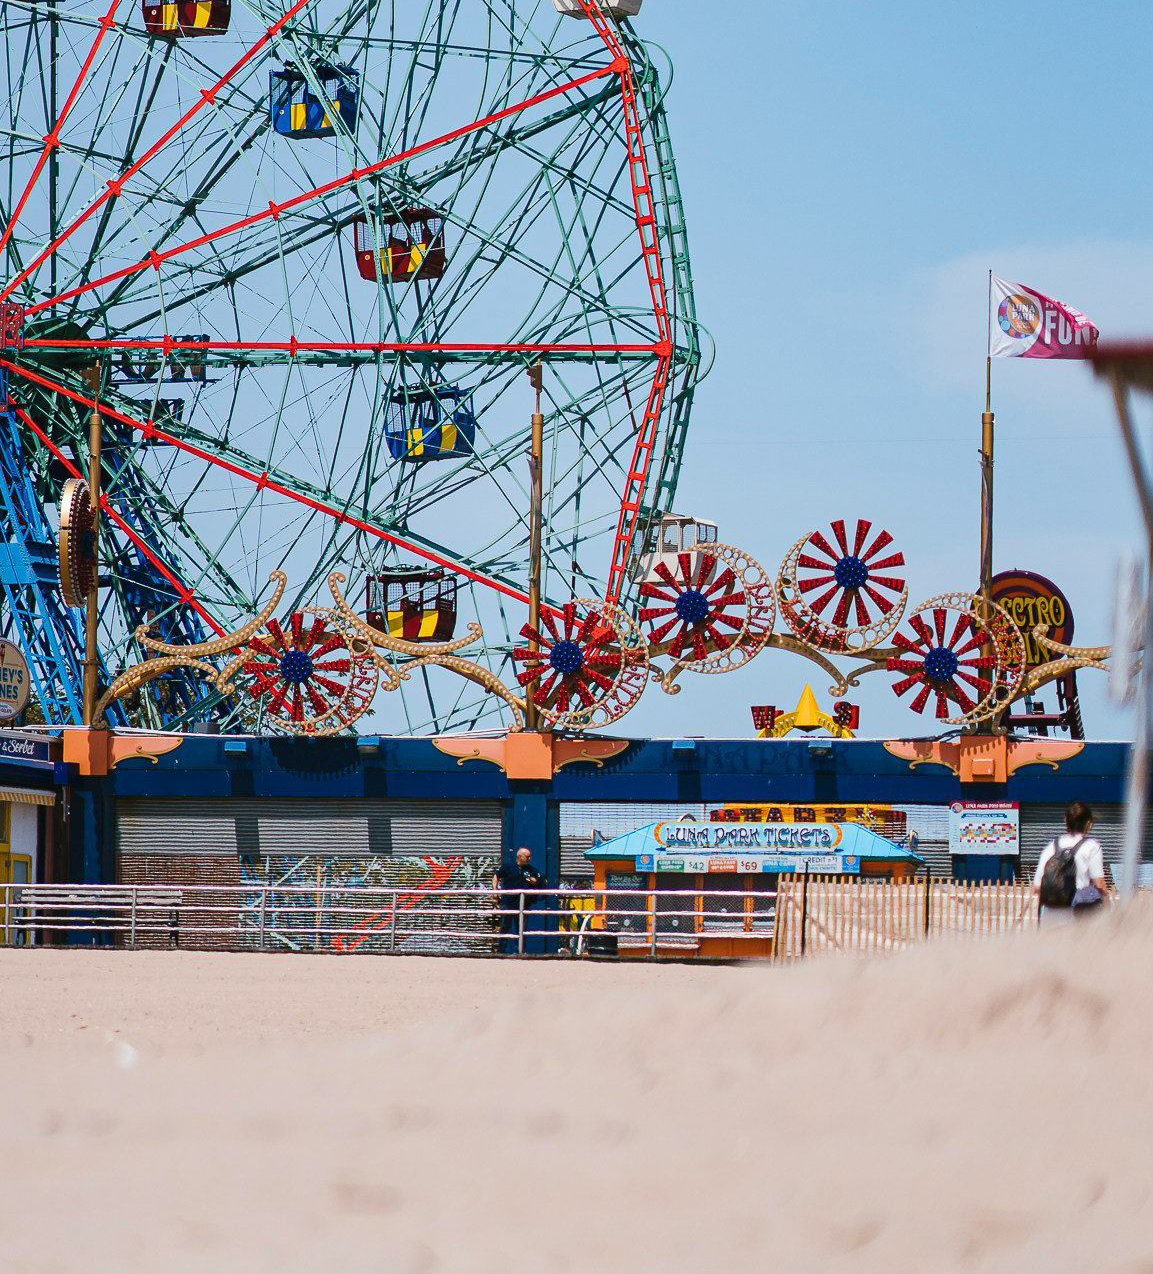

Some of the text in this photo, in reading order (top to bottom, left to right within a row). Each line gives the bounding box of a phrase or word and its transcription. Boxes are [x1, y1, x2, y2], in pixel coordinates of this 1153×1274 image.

[1011, 312, 1035, 322] PARK
[2, 740, 7, 751] &
[8, 739, 35, 755] Sorbet
[666, 827, 832, 846] LUNA PARK TICKETS
[689, 861, 705, 871] $42
[741, 861, 758, 871] $69
